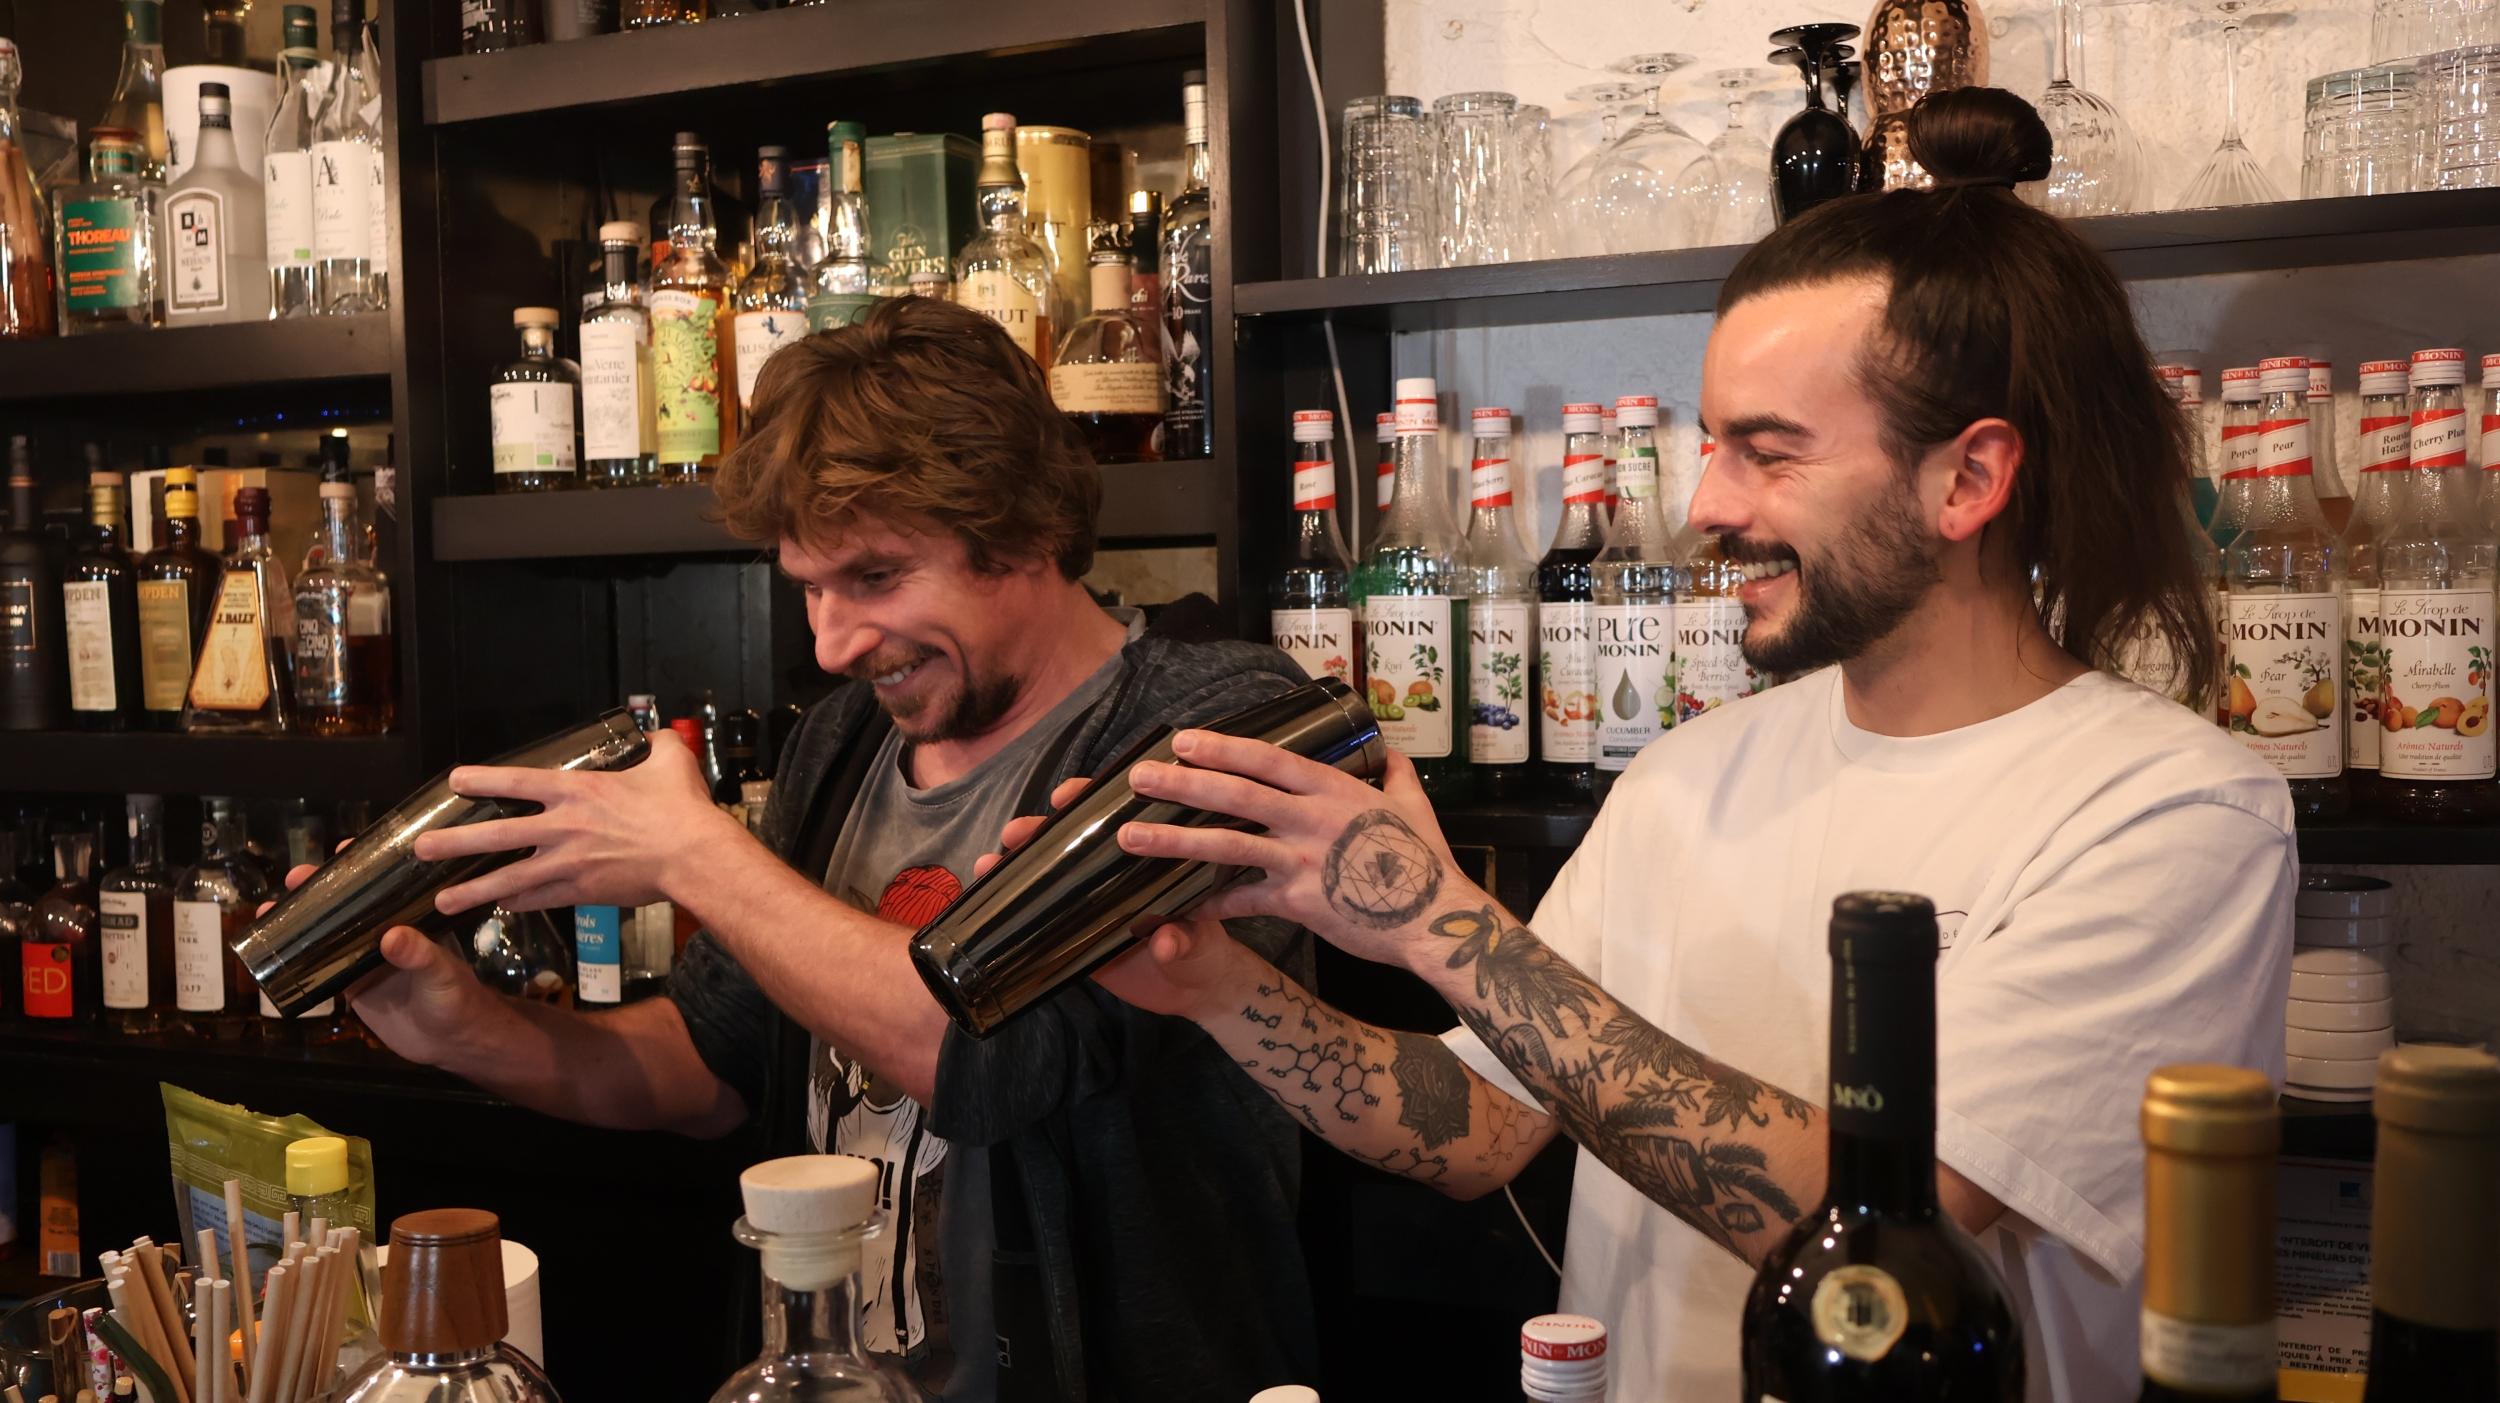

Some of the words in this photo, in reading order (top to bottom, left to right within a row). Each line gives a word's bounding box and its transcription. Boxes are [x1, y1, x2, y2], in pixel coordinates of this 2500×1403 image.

[67, 228, 132, 246] THOREAU
[2419, 351, 2462, 361] MONIN
[2273, 440, 2295, 452] Pear
[2413, 433, 2445, 450] Cherry
[2231, 447, 2258, 460] Popco
[2239, 604, 2256, 620] Le
[2258, 603, 2296, 623] Sirop
[2299, 609, 2316, 619] de
[2389, 599, 2407, 616] Le
[2409, 599, 2449, 618] Sirop
[2452, 604, 2469, 615] de
[225, 612, 256, 625] BALLY
[2232, 621, 2327, 641] MONIN
[2383, 617, 2480, 638] MONIN
[1543, 626, 1591, 643] MON
[1679, 629, 1741, 646] MONI
[1598, 644, 1660, 657] MONIN
[2259, 667, 2287, 683] Pear
[2402, 659, 2457, 678] Mirabelle
[1606, 727, 1651, 735] CUCUMBER
[1371, 1063, 1385, 1075] OH
[1303, 1080, 1322, 1093] OH
[1364, 1094, 1381, 1107] OH
[1340, 1111, 1359, 1124] OH
[2279, 1341, 2322, 1352] INTERDIT
[2328, 1347, 2341, 1355] DE
[2329, 1356, 2353, 1365] PRIX
